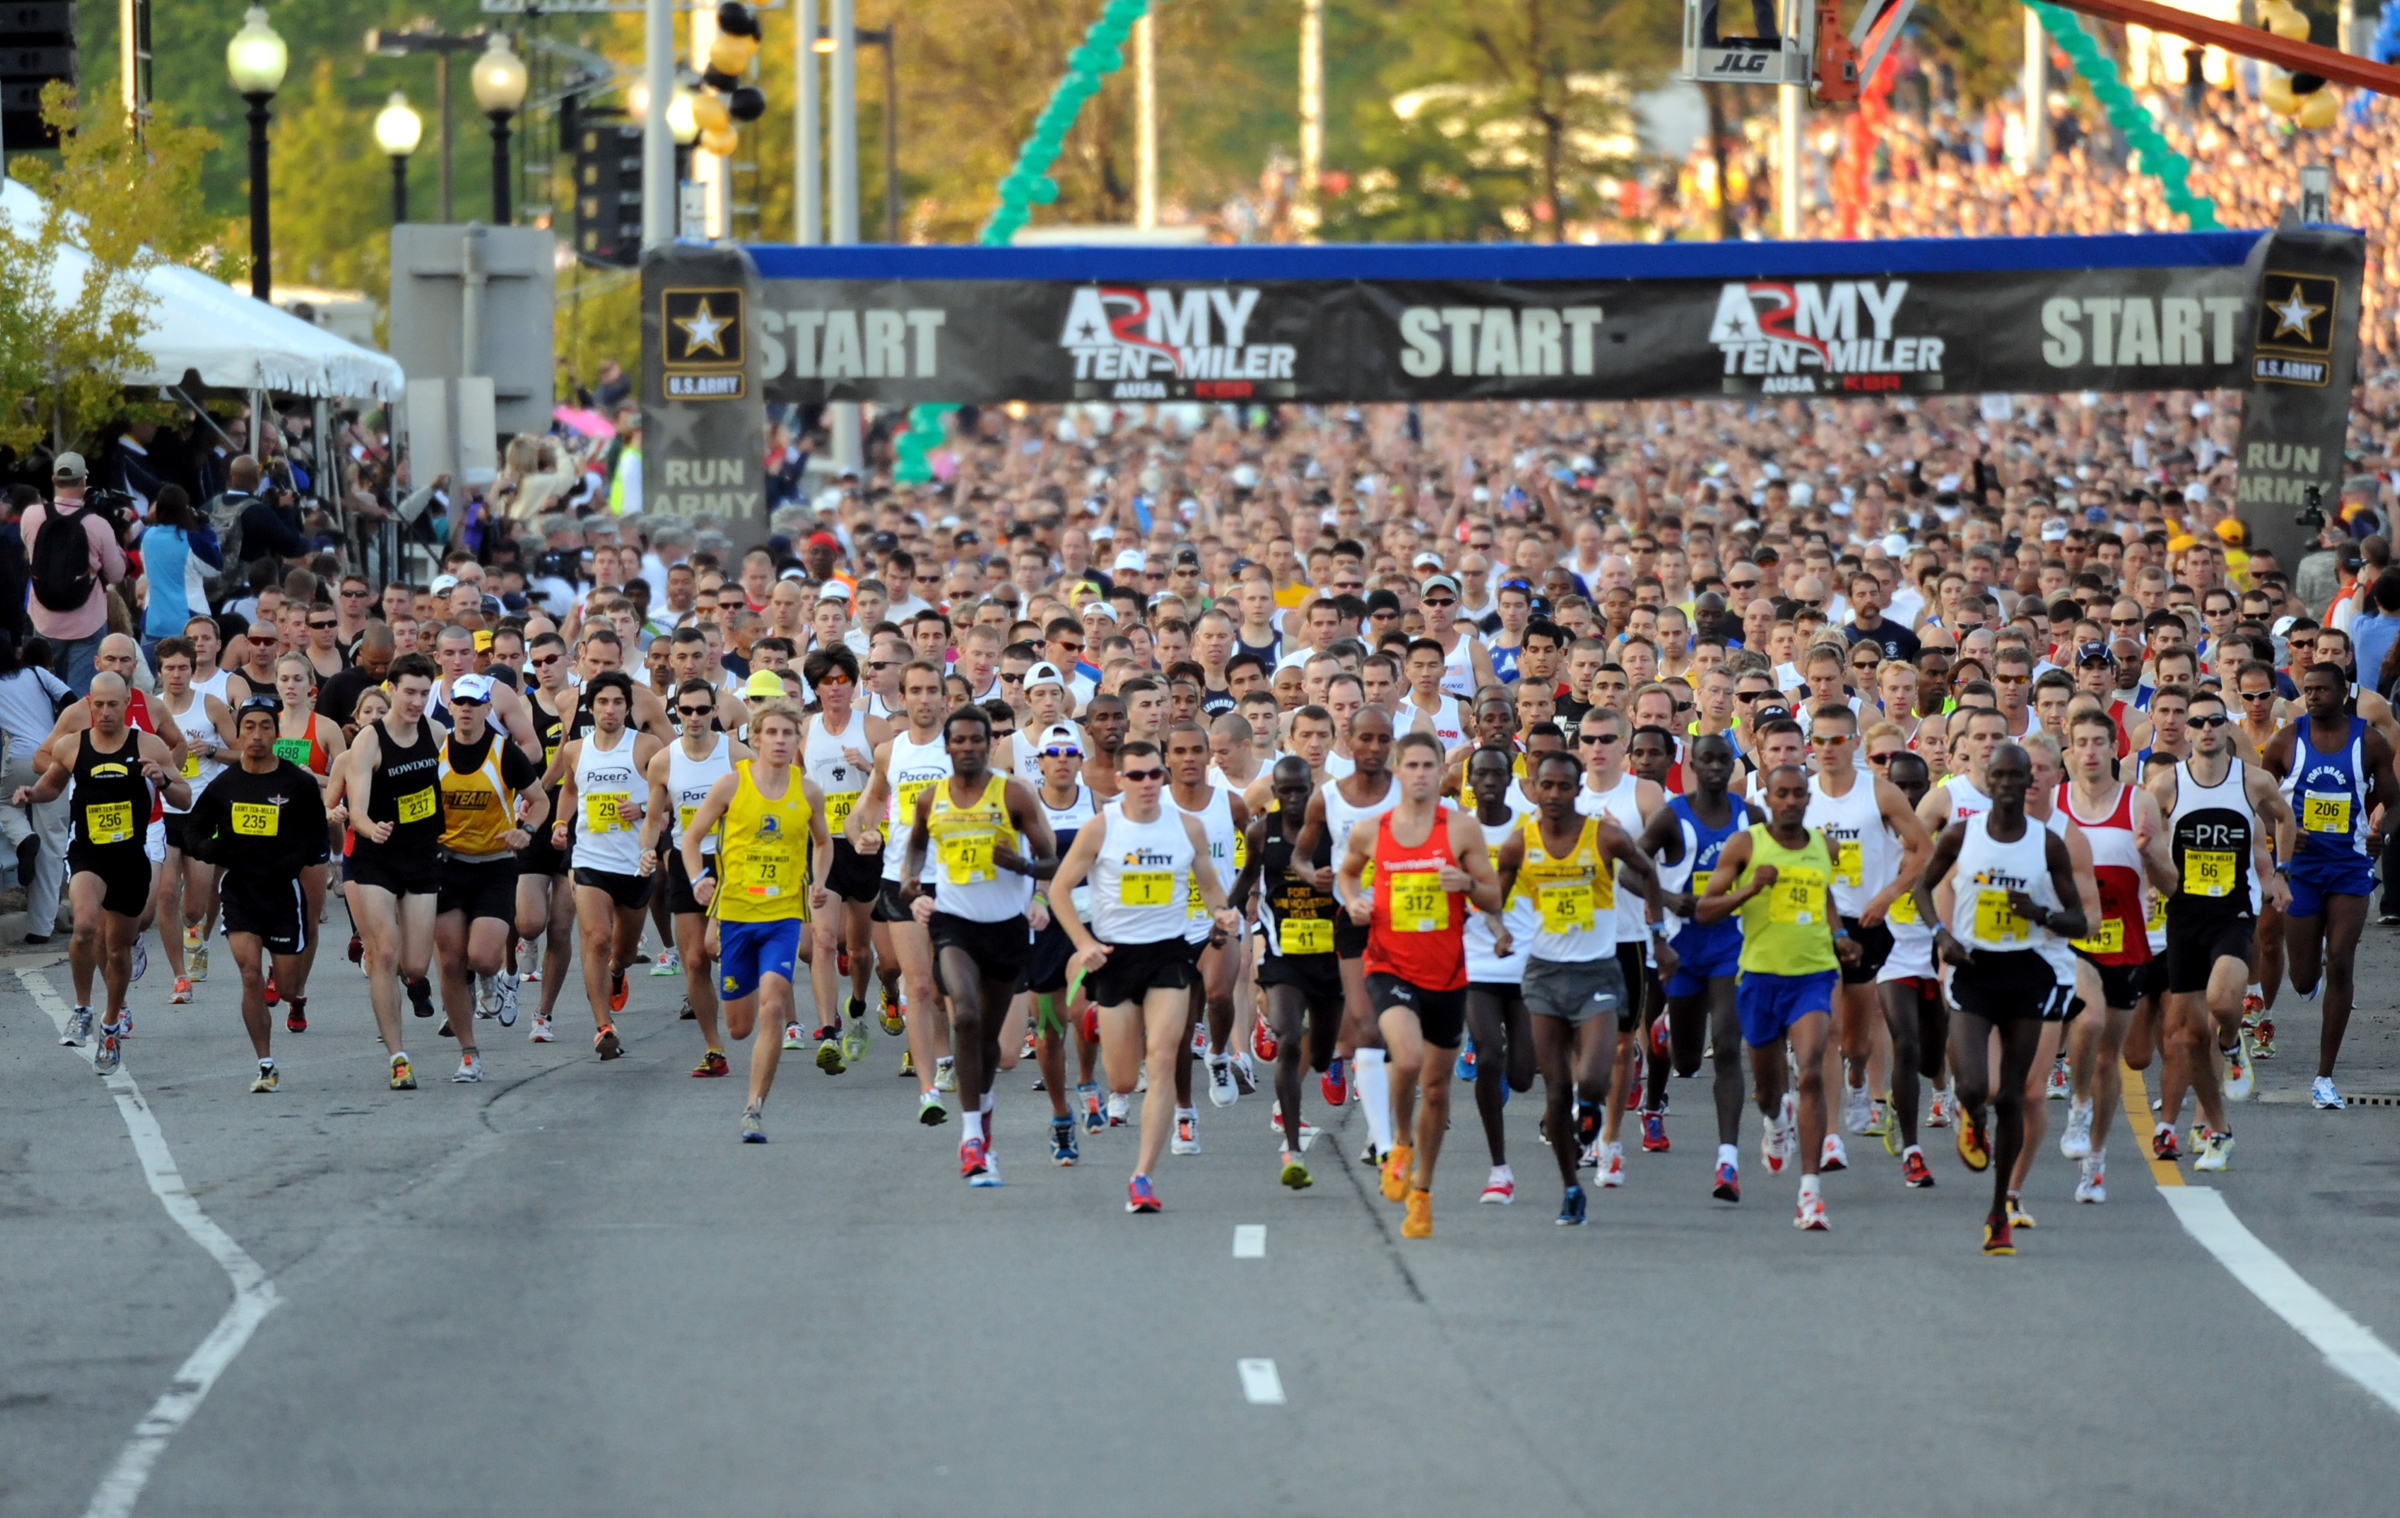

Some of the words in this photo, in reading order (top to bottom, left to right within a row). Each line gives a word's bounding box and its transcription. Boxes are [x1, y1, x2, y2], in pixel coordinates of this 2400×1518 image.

[1713, 53, 1769, 73] JLG
[1060, 286, 1261, 348] ARMY
[1709, 280, 1909, 343] ARMY
[2041, 297, 2244, 368] START
[761, 309, 946, 380] START
[1401, 307, 1603, 377] START
[1070, 344, 1297, 380] TEN-MILER
[1719, 335, 1946, 375] TEN-MILER
[1112, 381, 1168, 399] AUSA
[1761, 375, 1817, 393] AUSA
[2246, 442, 2321, 474] RUN
[665, 459, 744, 487] RUN
[652, 493, 759, 520] ARMY
[1202, 698, 1235, 714] LEONARD
[277, 746, 300, 760] 698
[387, 757, 438, 778] BOWDOIN
[2306, 766, 2323, 784] FORT
[2323, 765, 2347, 785] BRAGG
[586, 770, 629, 783] Pacers
[898, 770, 944, 783] Pacers
[452, 791, 490, 806] TEAM
[682, 790, 708, 802] Pac
[409, 798, 430, 817] 237
[599, 802, 616, 817] 29
[834, 802, 850, 817] 40
[2314, 802, 2340, 817] 206
[97, 812, 122, 828] 256
[241, 813, 267, 830] 235
[960, 848, 977, 863] 47
[760, 864, 777, 879] 73
[2201, 862, 2218, 878] 66
[1143, 884, 1151, 899] 1
[1789, 887, 1808, 904] 48
[1404, 895, 1435, 911] 312
[1556, 900, 1575, 915] 45
[1995, 911, 2012, 925] 11
[1298, 932, 1314, 947] 41
